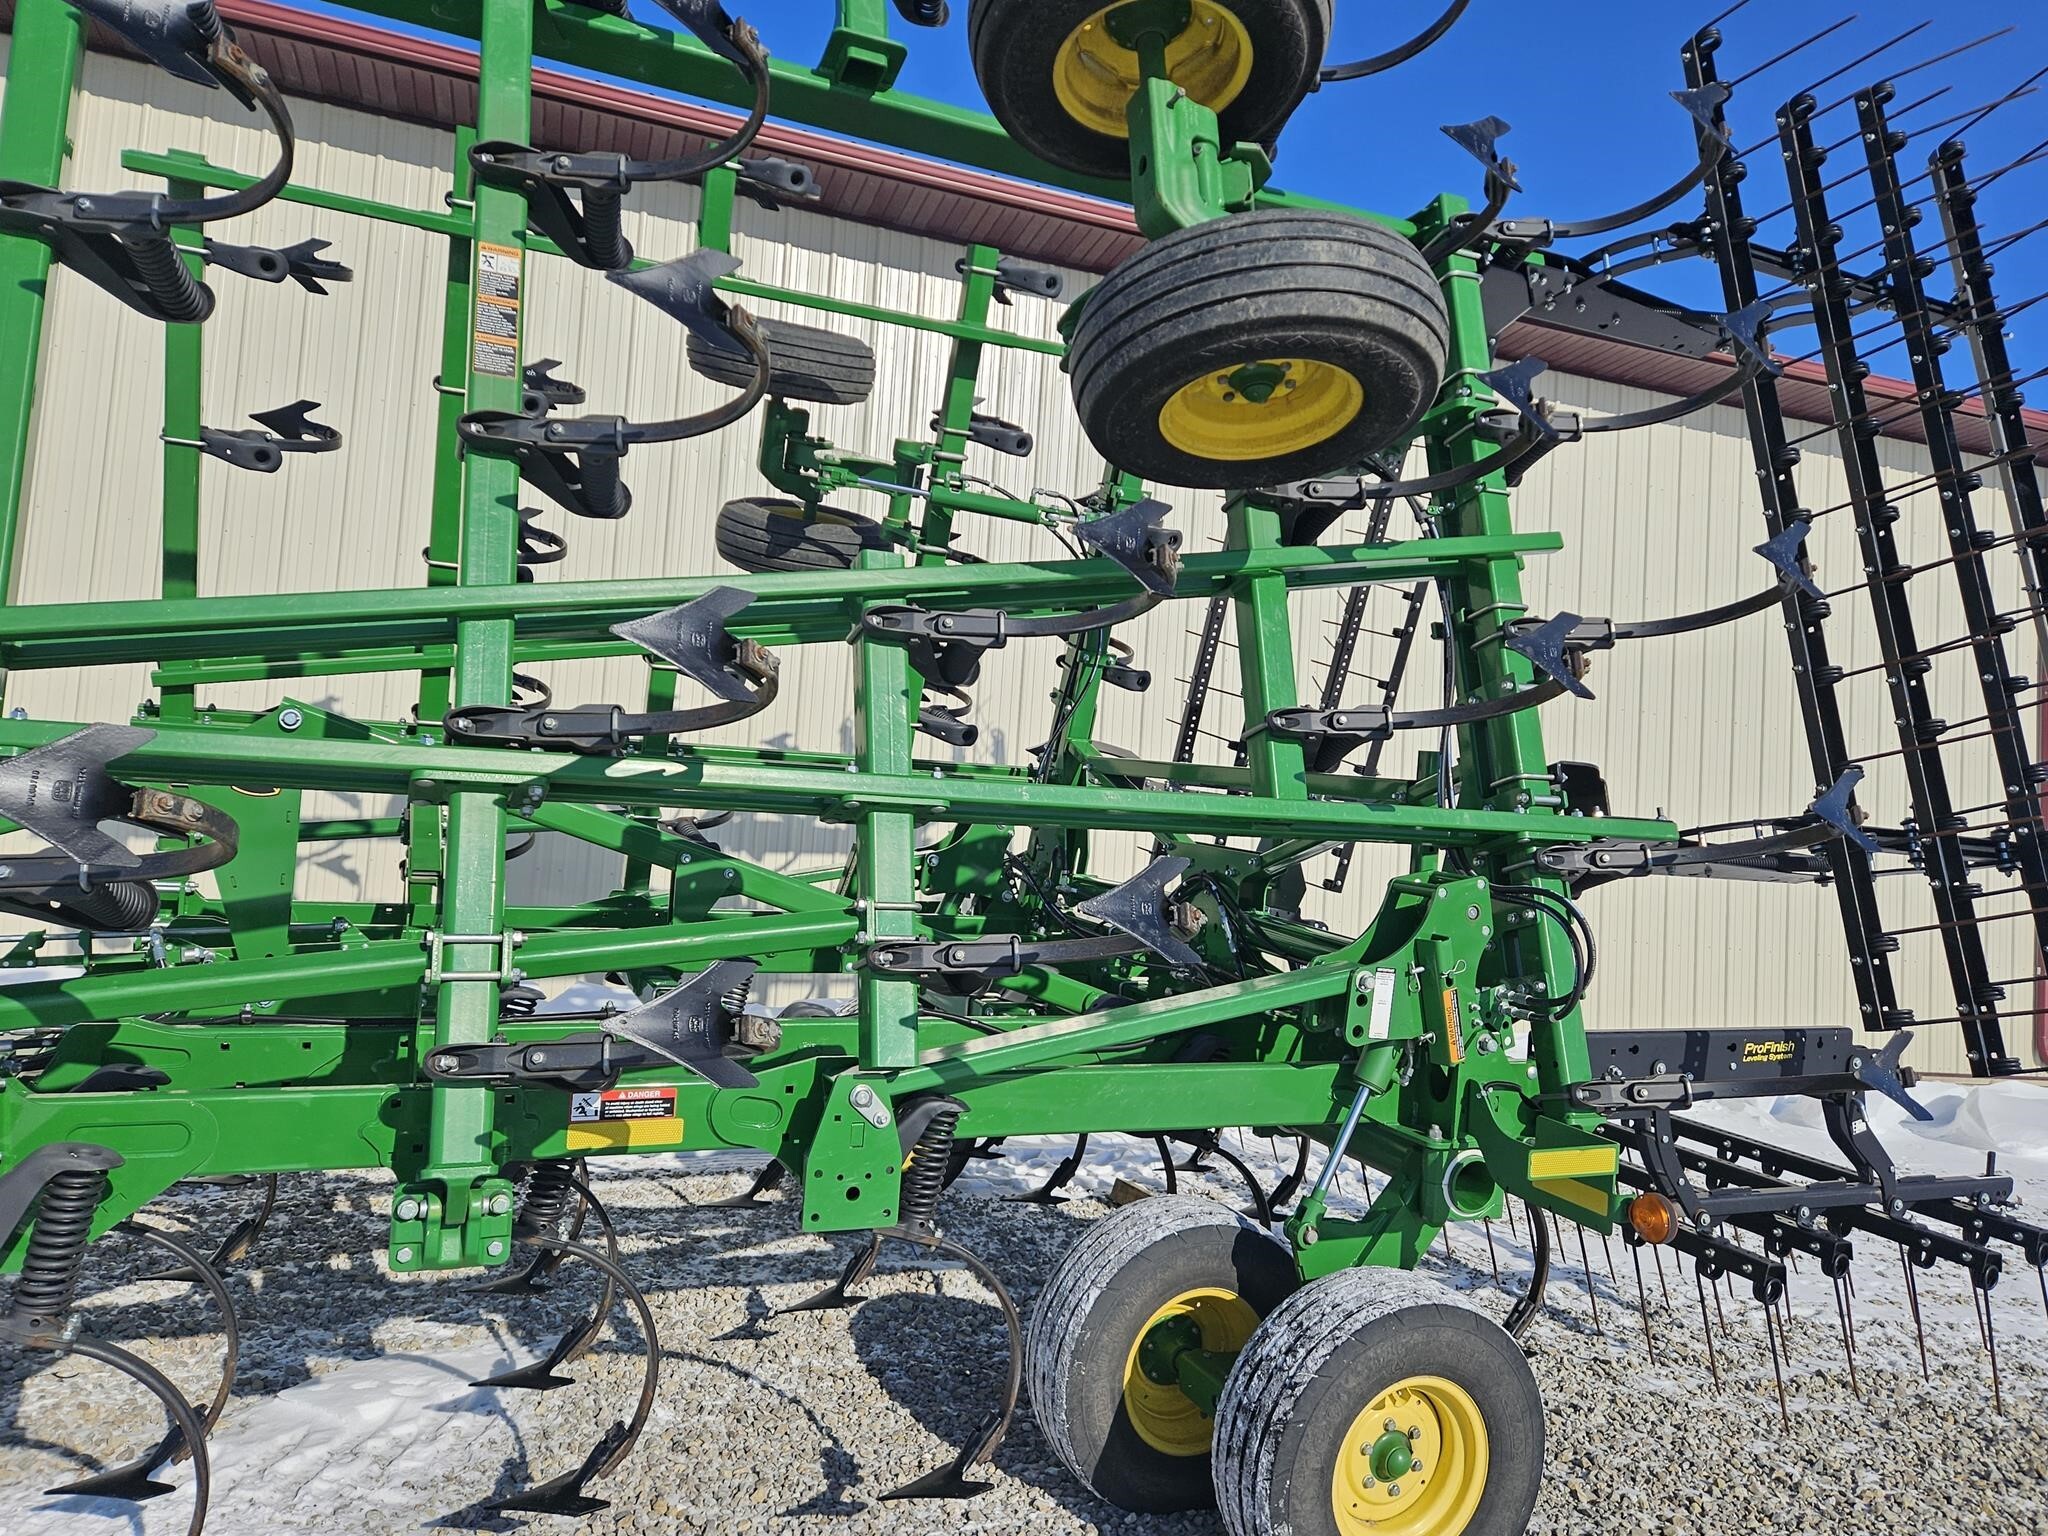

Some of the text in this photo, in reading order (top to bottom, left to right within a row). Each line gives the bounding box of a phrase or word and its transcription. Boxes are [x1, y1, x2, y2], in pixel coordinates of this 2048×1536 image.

[1446, 1006, 1456, 1039] WARNING
[1744, 1041, 1795, 1055] ProFinish
[1742, 1053, 1793, 1062] Leveling System
[627, 1090, 661, 1099] DANGER
